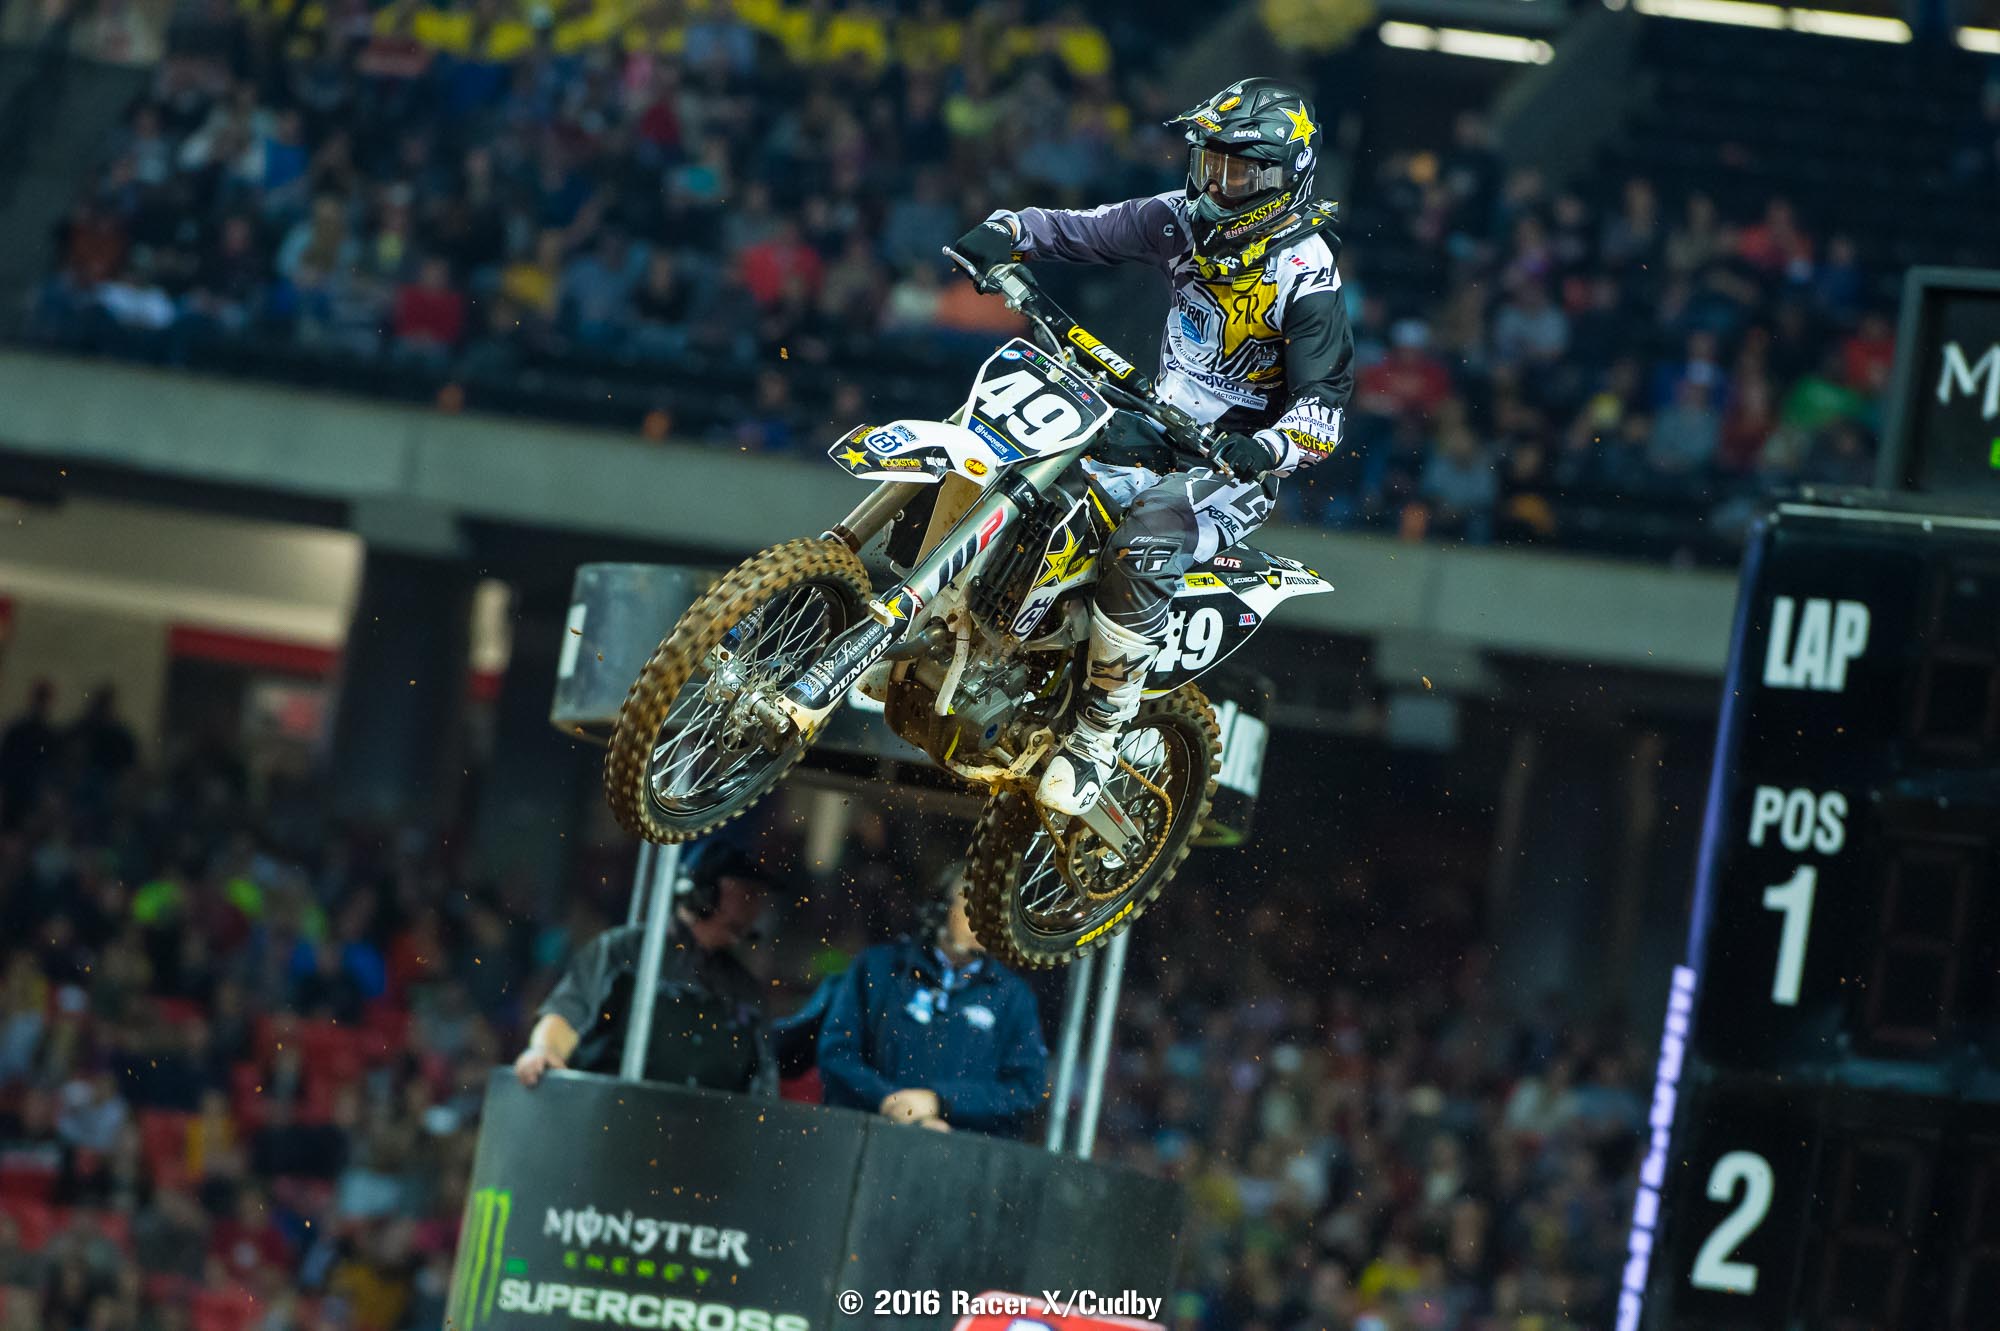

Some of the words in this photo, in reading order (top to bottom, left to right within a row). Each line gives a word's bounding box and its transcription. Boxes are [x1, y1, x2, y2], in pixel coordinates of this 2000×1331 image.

[976, 369, 1082, 452] 49
[1213, 557, 1242, 569] GUTS
[1284, 576, 1320, 585] DUNLOP
[828, 632, 893, 702] DUNLOP
[1763, 597, 1870, 692] LAP
[1749, 785, 1848, 855] POS
[1762, 864, 1817, 1006] 1
[543, 1204, 751, 1267] MONSTER
[1690, 1150, 1775, 1294] 2
[498, 1277, 811, 1331] SUPERCROSS
